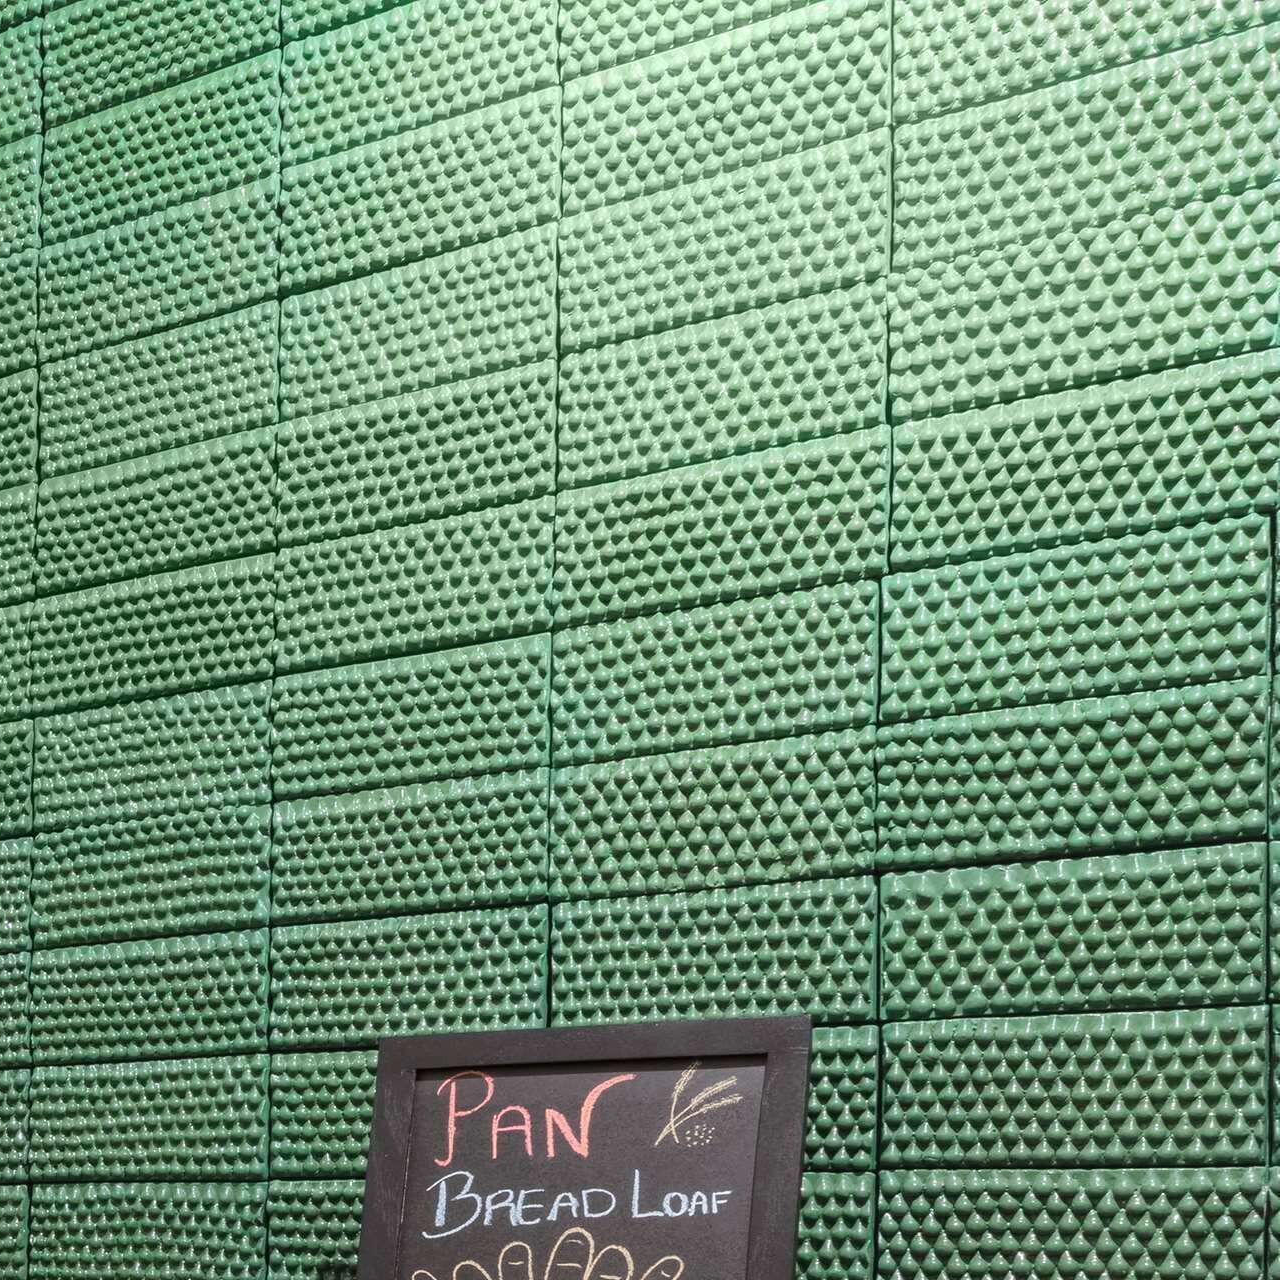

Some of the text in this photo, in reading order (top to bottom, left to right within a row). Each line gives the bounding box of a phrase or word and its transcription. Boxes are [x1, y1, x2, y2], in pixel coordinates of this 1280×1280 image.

[434, 1070, 638, 1167] PAN
[422, 1168, 733, 1239] BREAD LOAF
